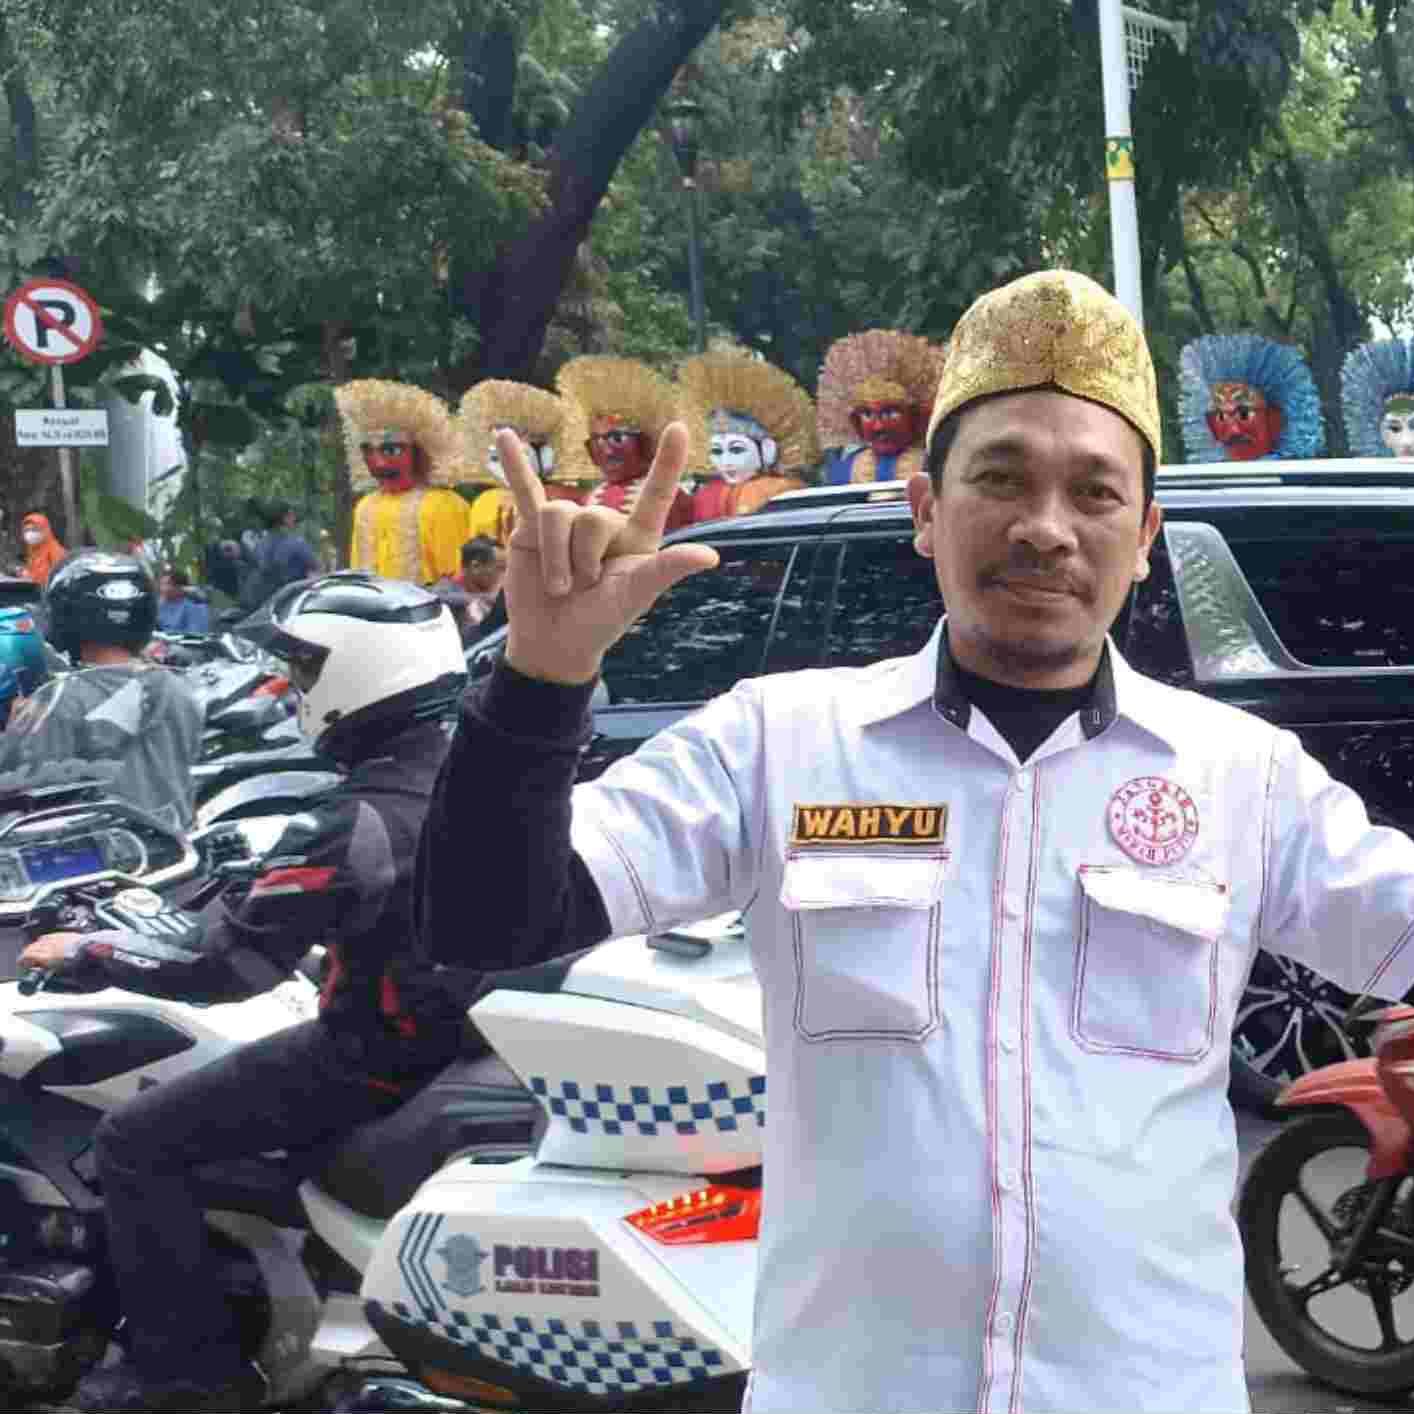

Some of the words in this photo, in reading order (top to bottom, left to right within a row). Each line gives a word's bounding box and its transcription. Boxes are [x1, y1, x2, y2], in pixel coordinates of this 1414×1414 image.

[34, 299, 76, 348] P
[801, 809, 937, 837] WAHYU
[493, 1245, 600, 1281] POLISI
